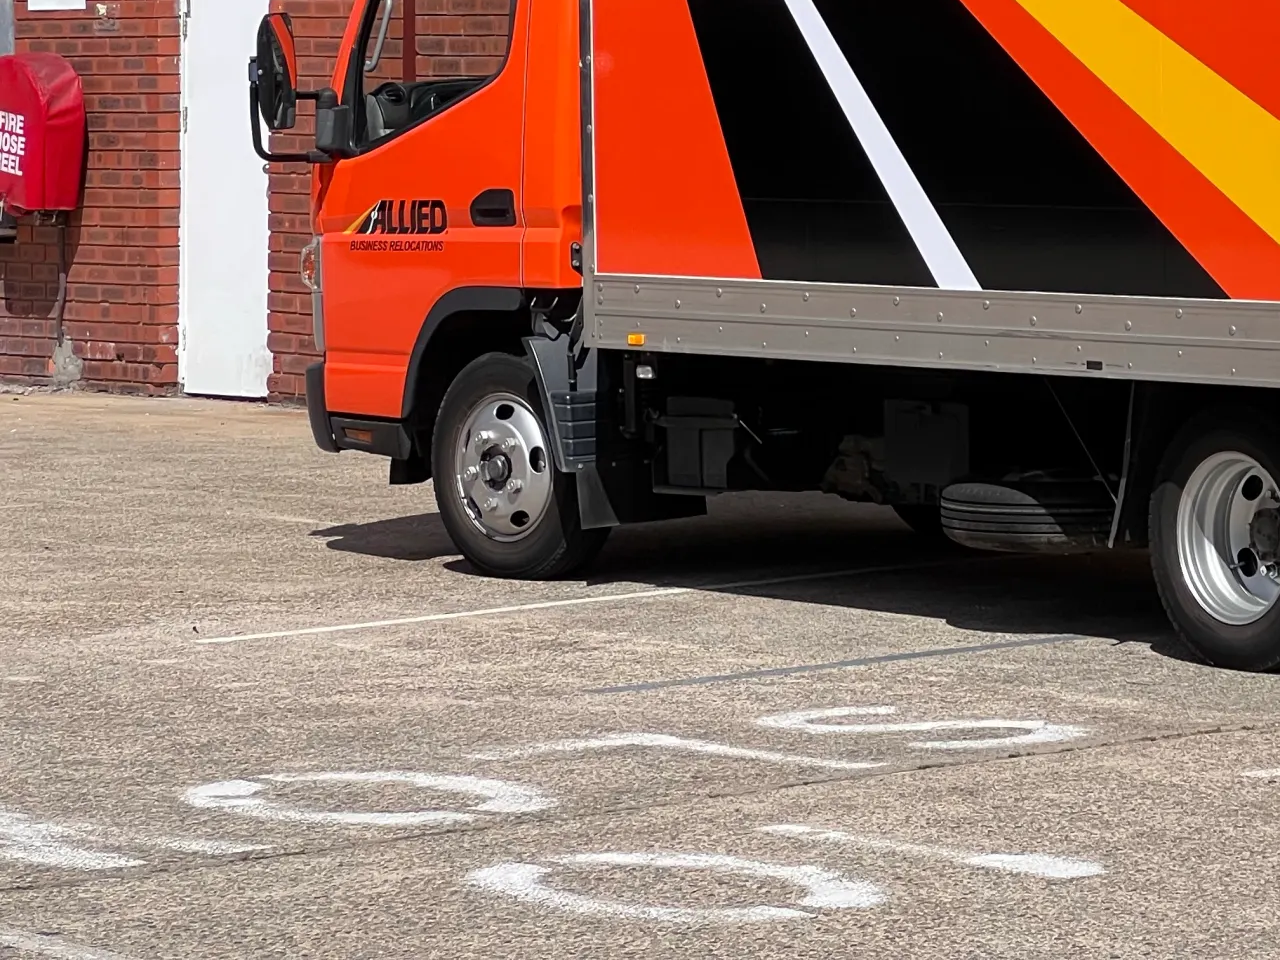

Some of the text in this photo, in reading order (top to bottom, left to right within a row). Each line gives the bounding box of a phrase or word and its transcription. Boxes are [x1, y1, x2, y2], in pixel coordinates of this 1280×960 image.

[0, 152, 23, 176] EEL
[357, 200, 448, 234] ALLIED
[350, 240, 444, 251] BUSINESS RELOCATIONS
